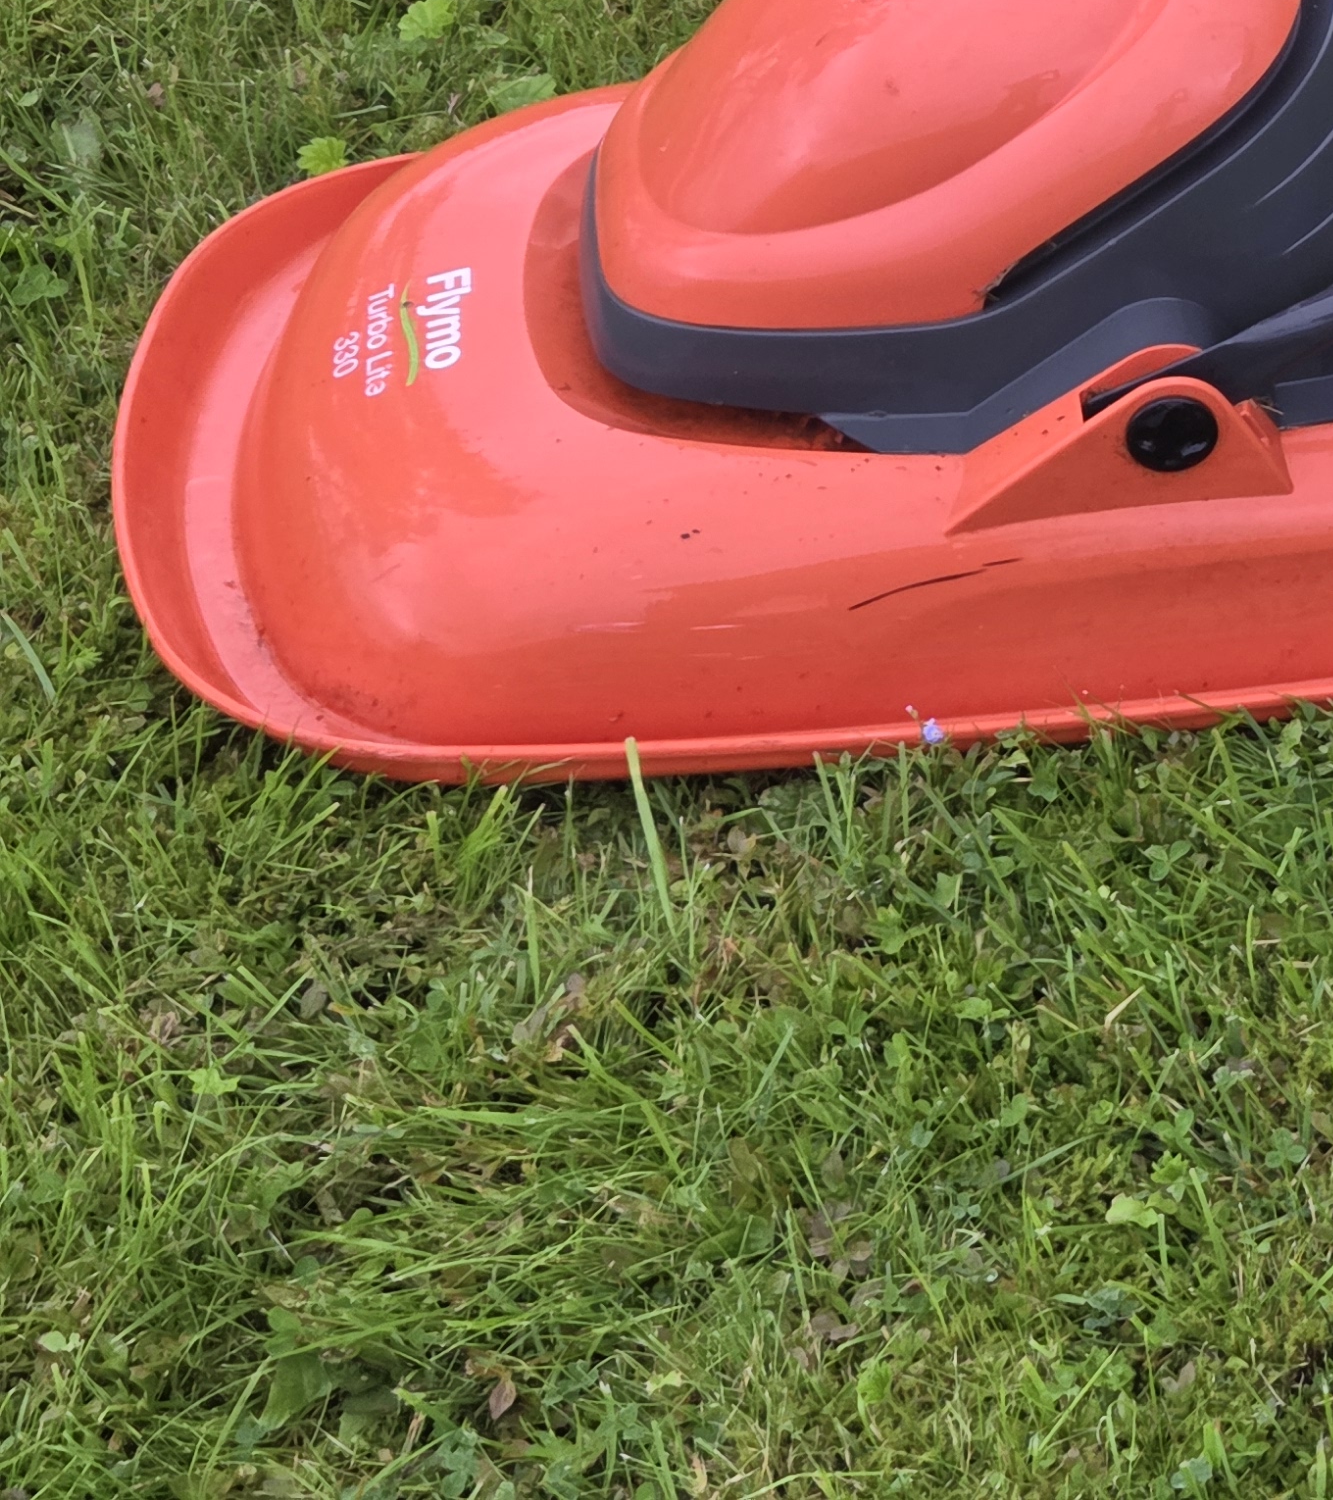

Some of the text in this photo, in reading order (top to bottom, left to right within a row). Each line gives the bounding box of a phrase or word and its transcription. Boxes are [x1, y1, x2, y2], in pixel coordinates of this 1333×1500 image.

[333, 332, 360, 378] 330
[365, 283, 395, 397] Turbo Lite
[416, 267, 472, 369] Flymo
